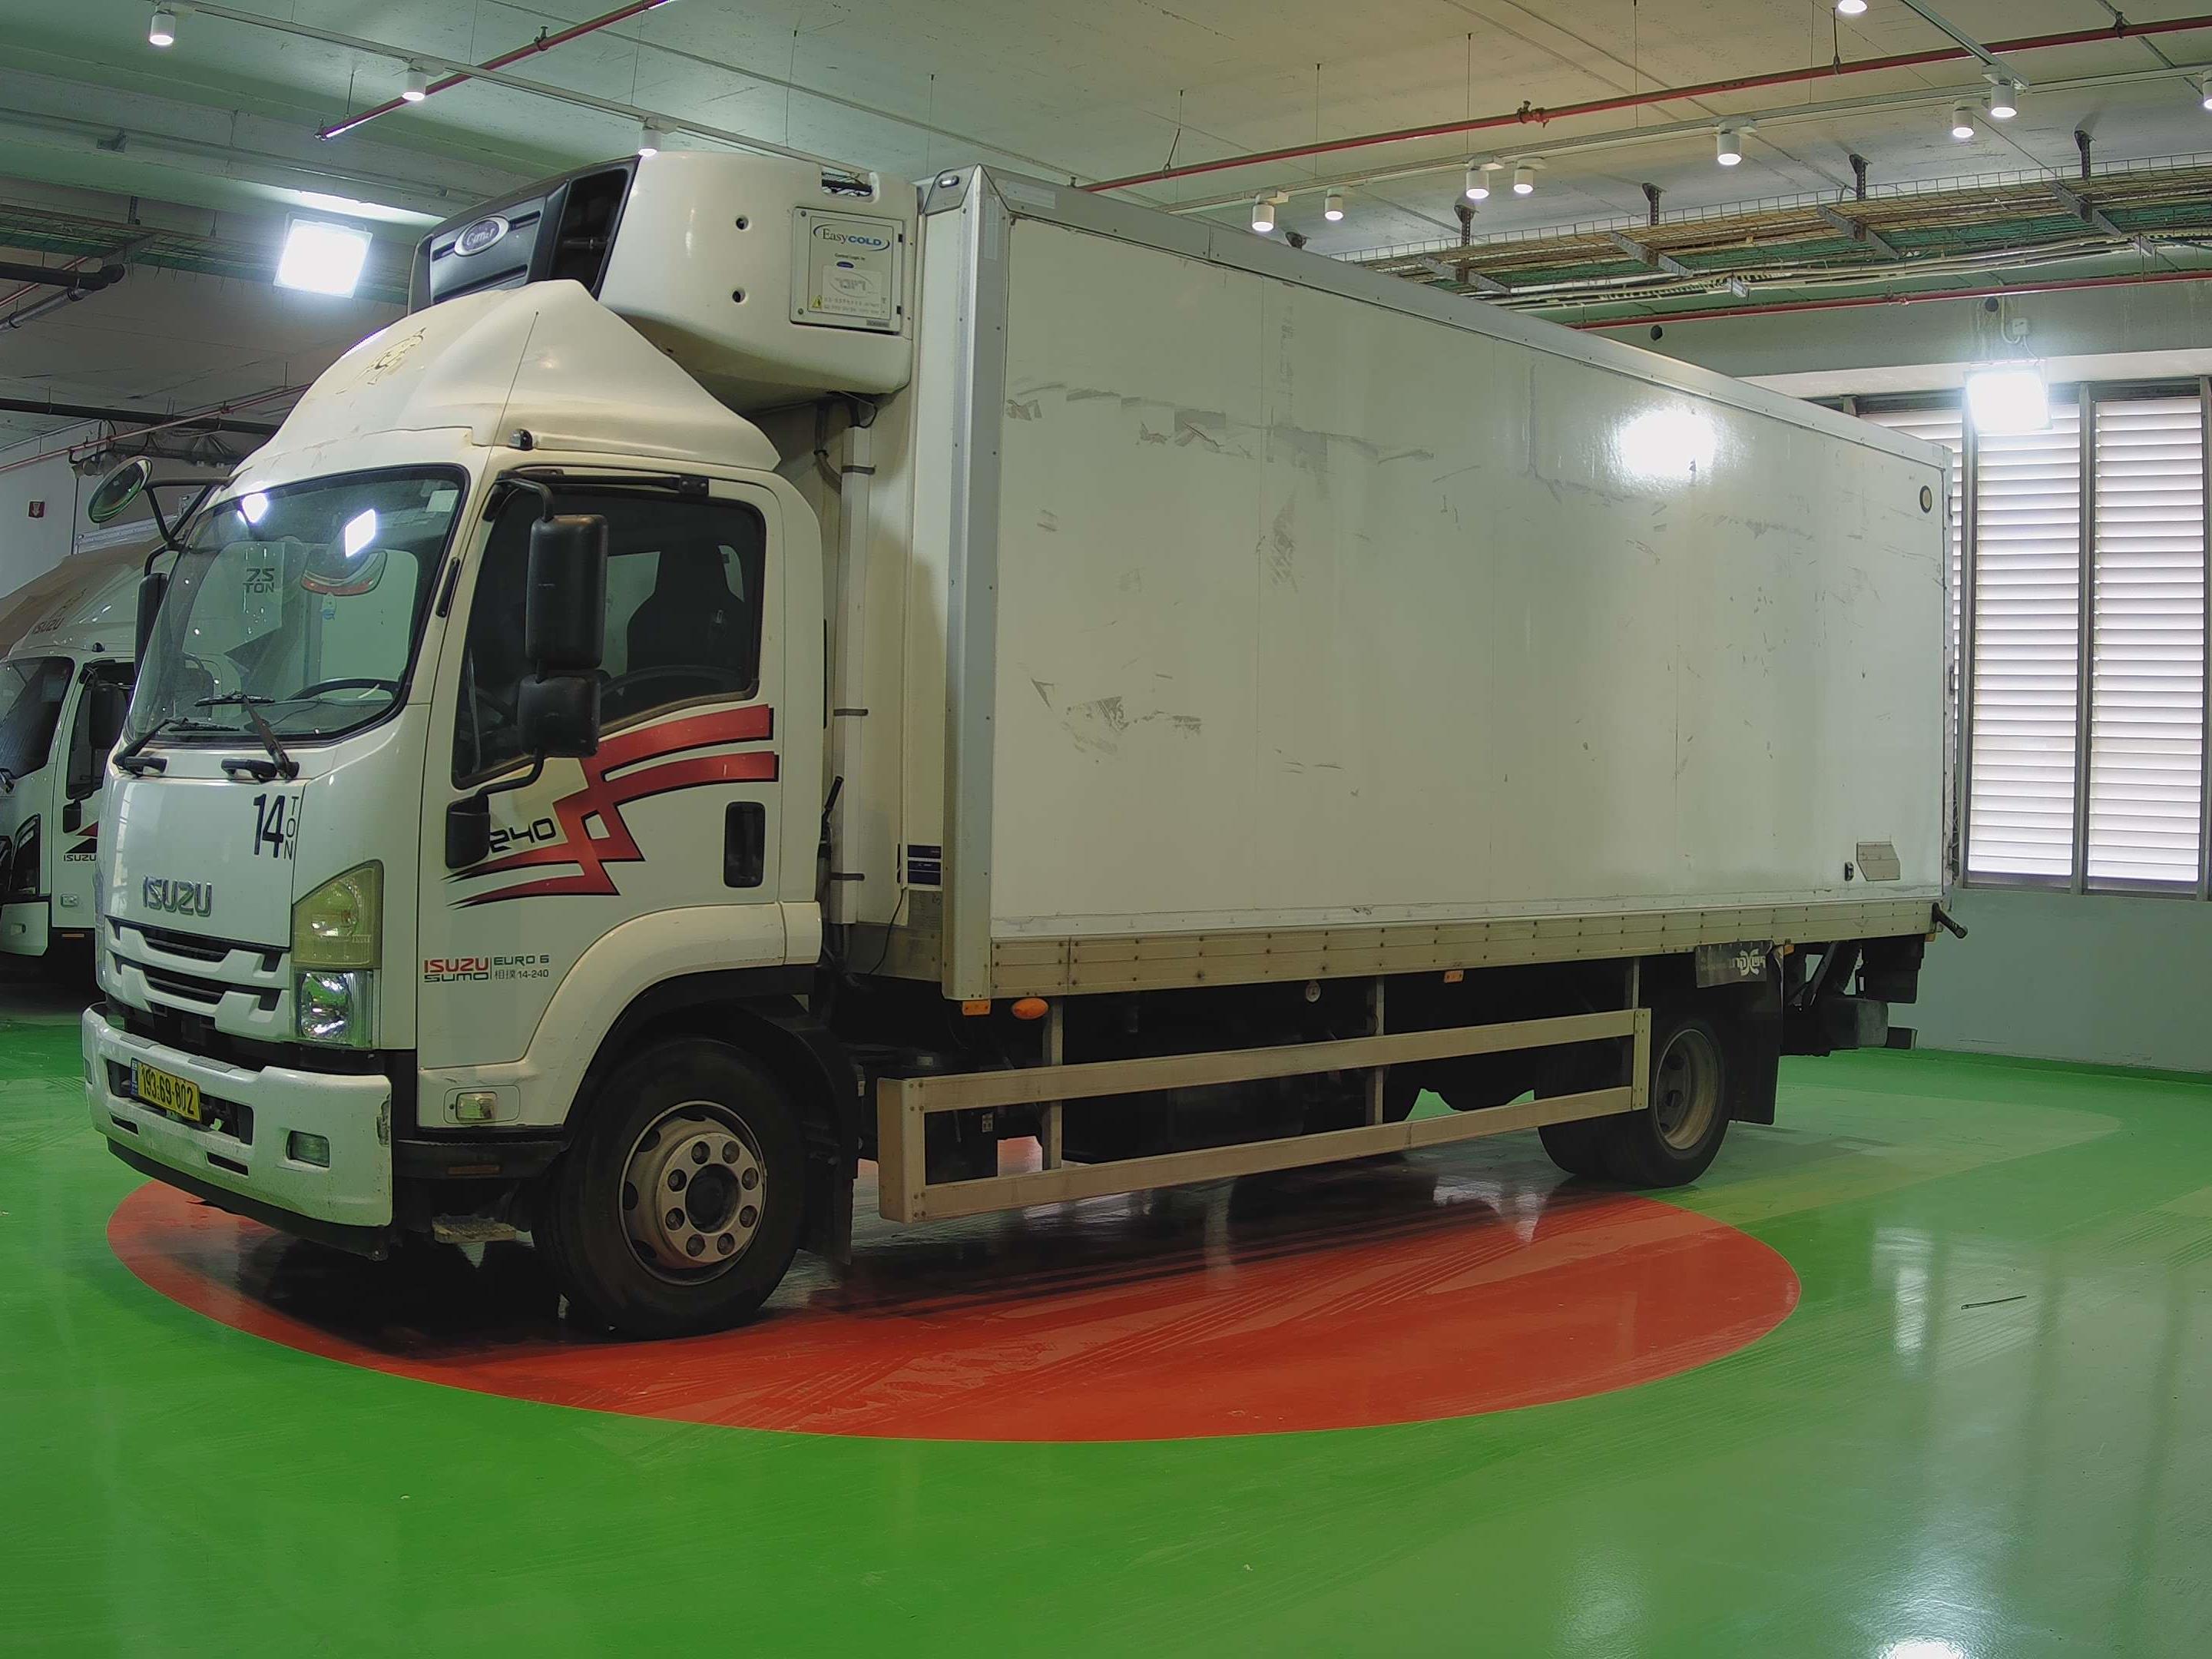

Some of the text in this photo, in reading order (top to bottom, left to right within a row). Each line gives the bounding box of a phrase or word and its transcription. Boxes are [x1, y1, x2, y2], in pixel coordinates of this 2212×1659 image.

[243, 582, 275, 593] TON
[253, 793, 299, 860] 14 TON
[142, 876, 213, 917] ISUZU
[424, 957, 489, 973] ISUZU
[494, 955, 549, 966] EURO 6
[518, 969, 549, 979] 14-240
